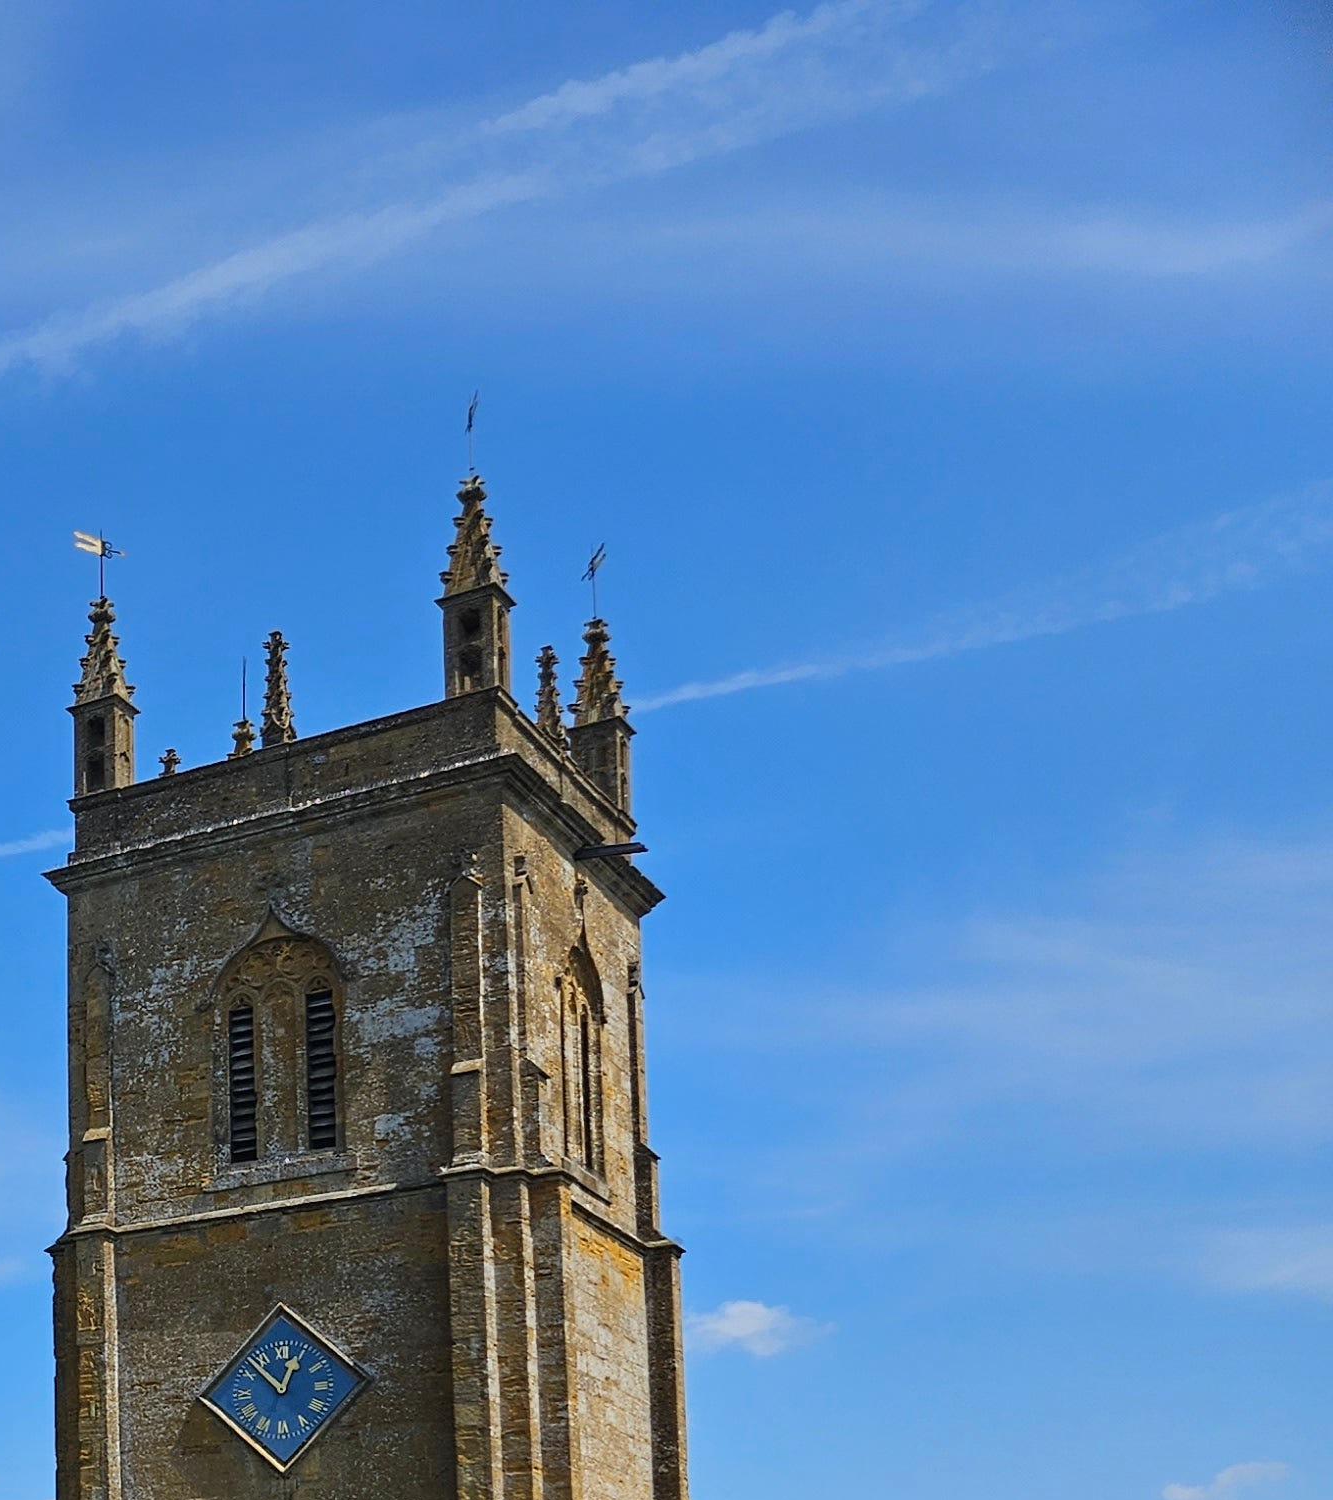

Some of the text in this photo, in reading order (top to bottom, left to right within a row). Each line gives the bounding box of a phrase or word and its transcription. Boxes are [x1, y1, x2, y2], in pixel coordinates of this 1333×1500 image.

[274, 1346, 289, 1360] XII
[256, 1352, 270, 1367] XI
[309, 1362, 323, 1373] II
[242, 1369, 256, 1380] X
[314, 1381, 328, 1390] III
[238, 1389, 252, 1400] IX
[298, 1415, 309, 1427] V
[278, 1420, 289, 1434] VI
